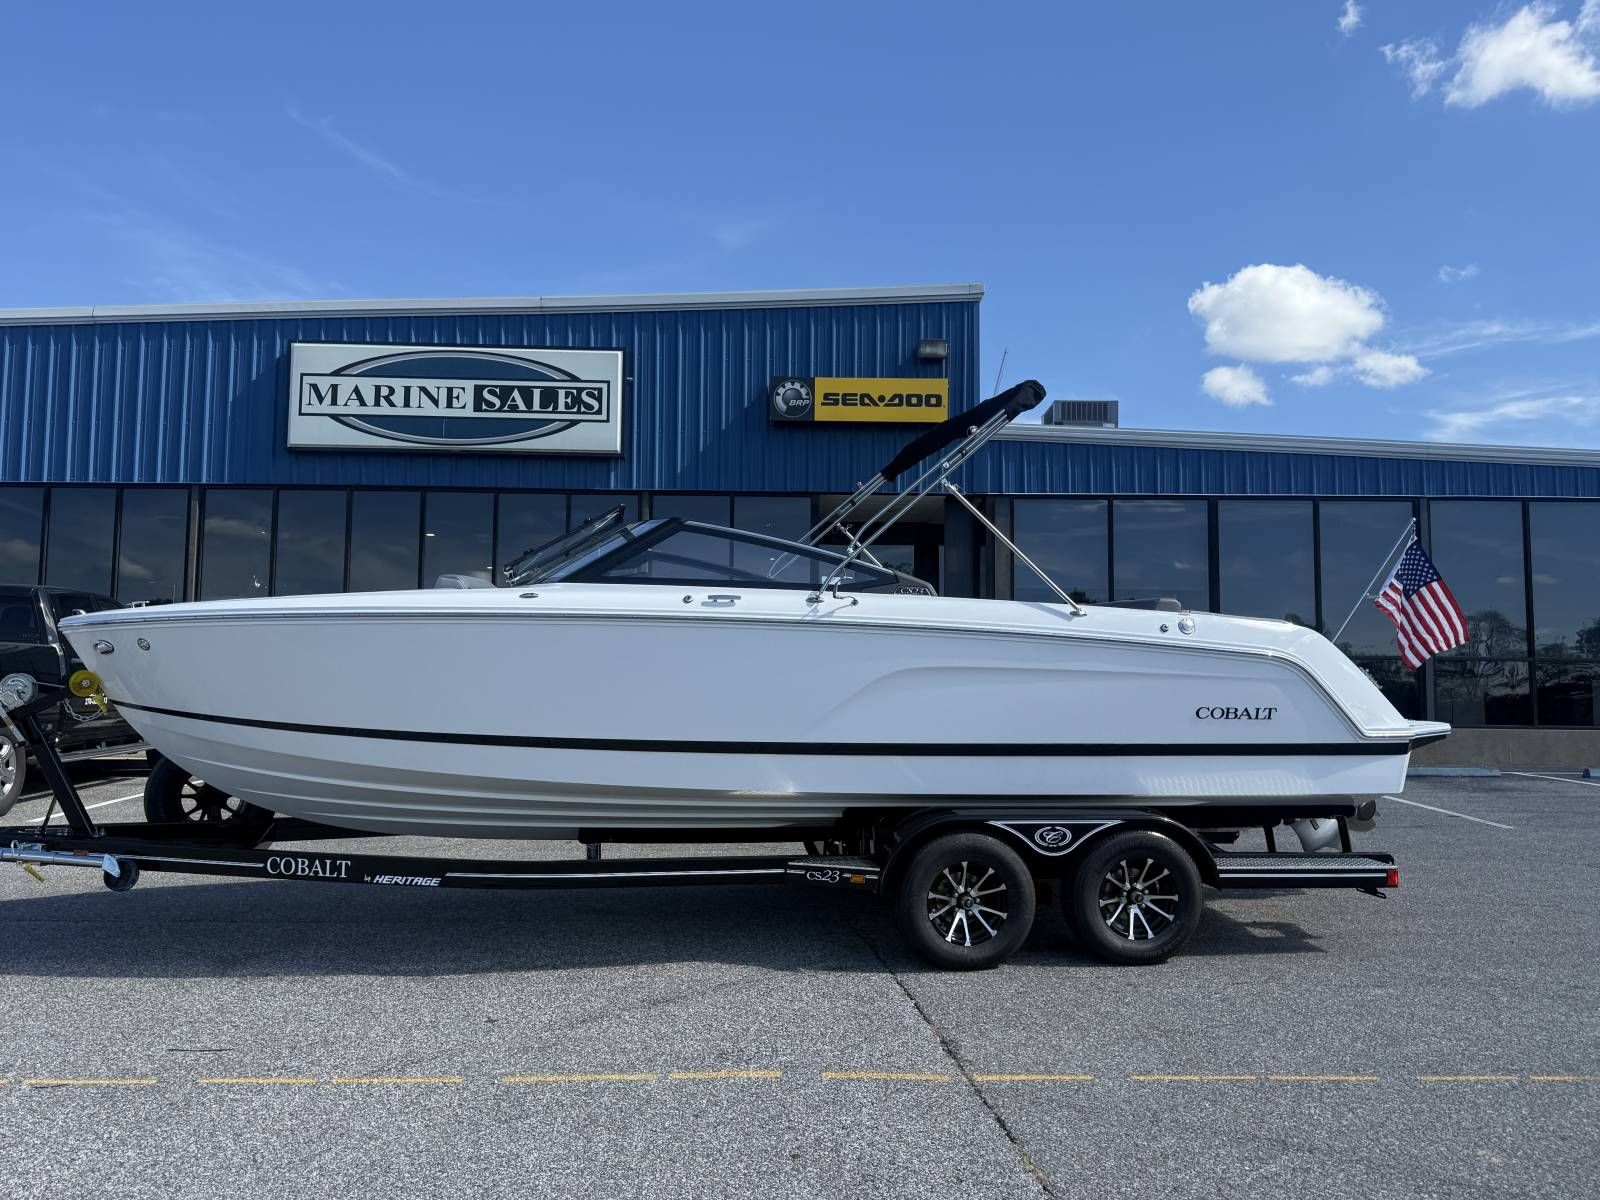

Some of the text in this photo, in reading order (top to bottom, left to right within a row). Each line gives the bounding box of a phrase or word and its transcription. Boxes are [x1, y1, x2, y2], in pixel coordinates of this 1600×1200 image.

[305, 383, 600, 413] MARINE SALES
[1195, 706, 1278, 720] COBALT
[266, 856, 351, 878] COBALT
[373, 875, 442, 886] HERITAGE
